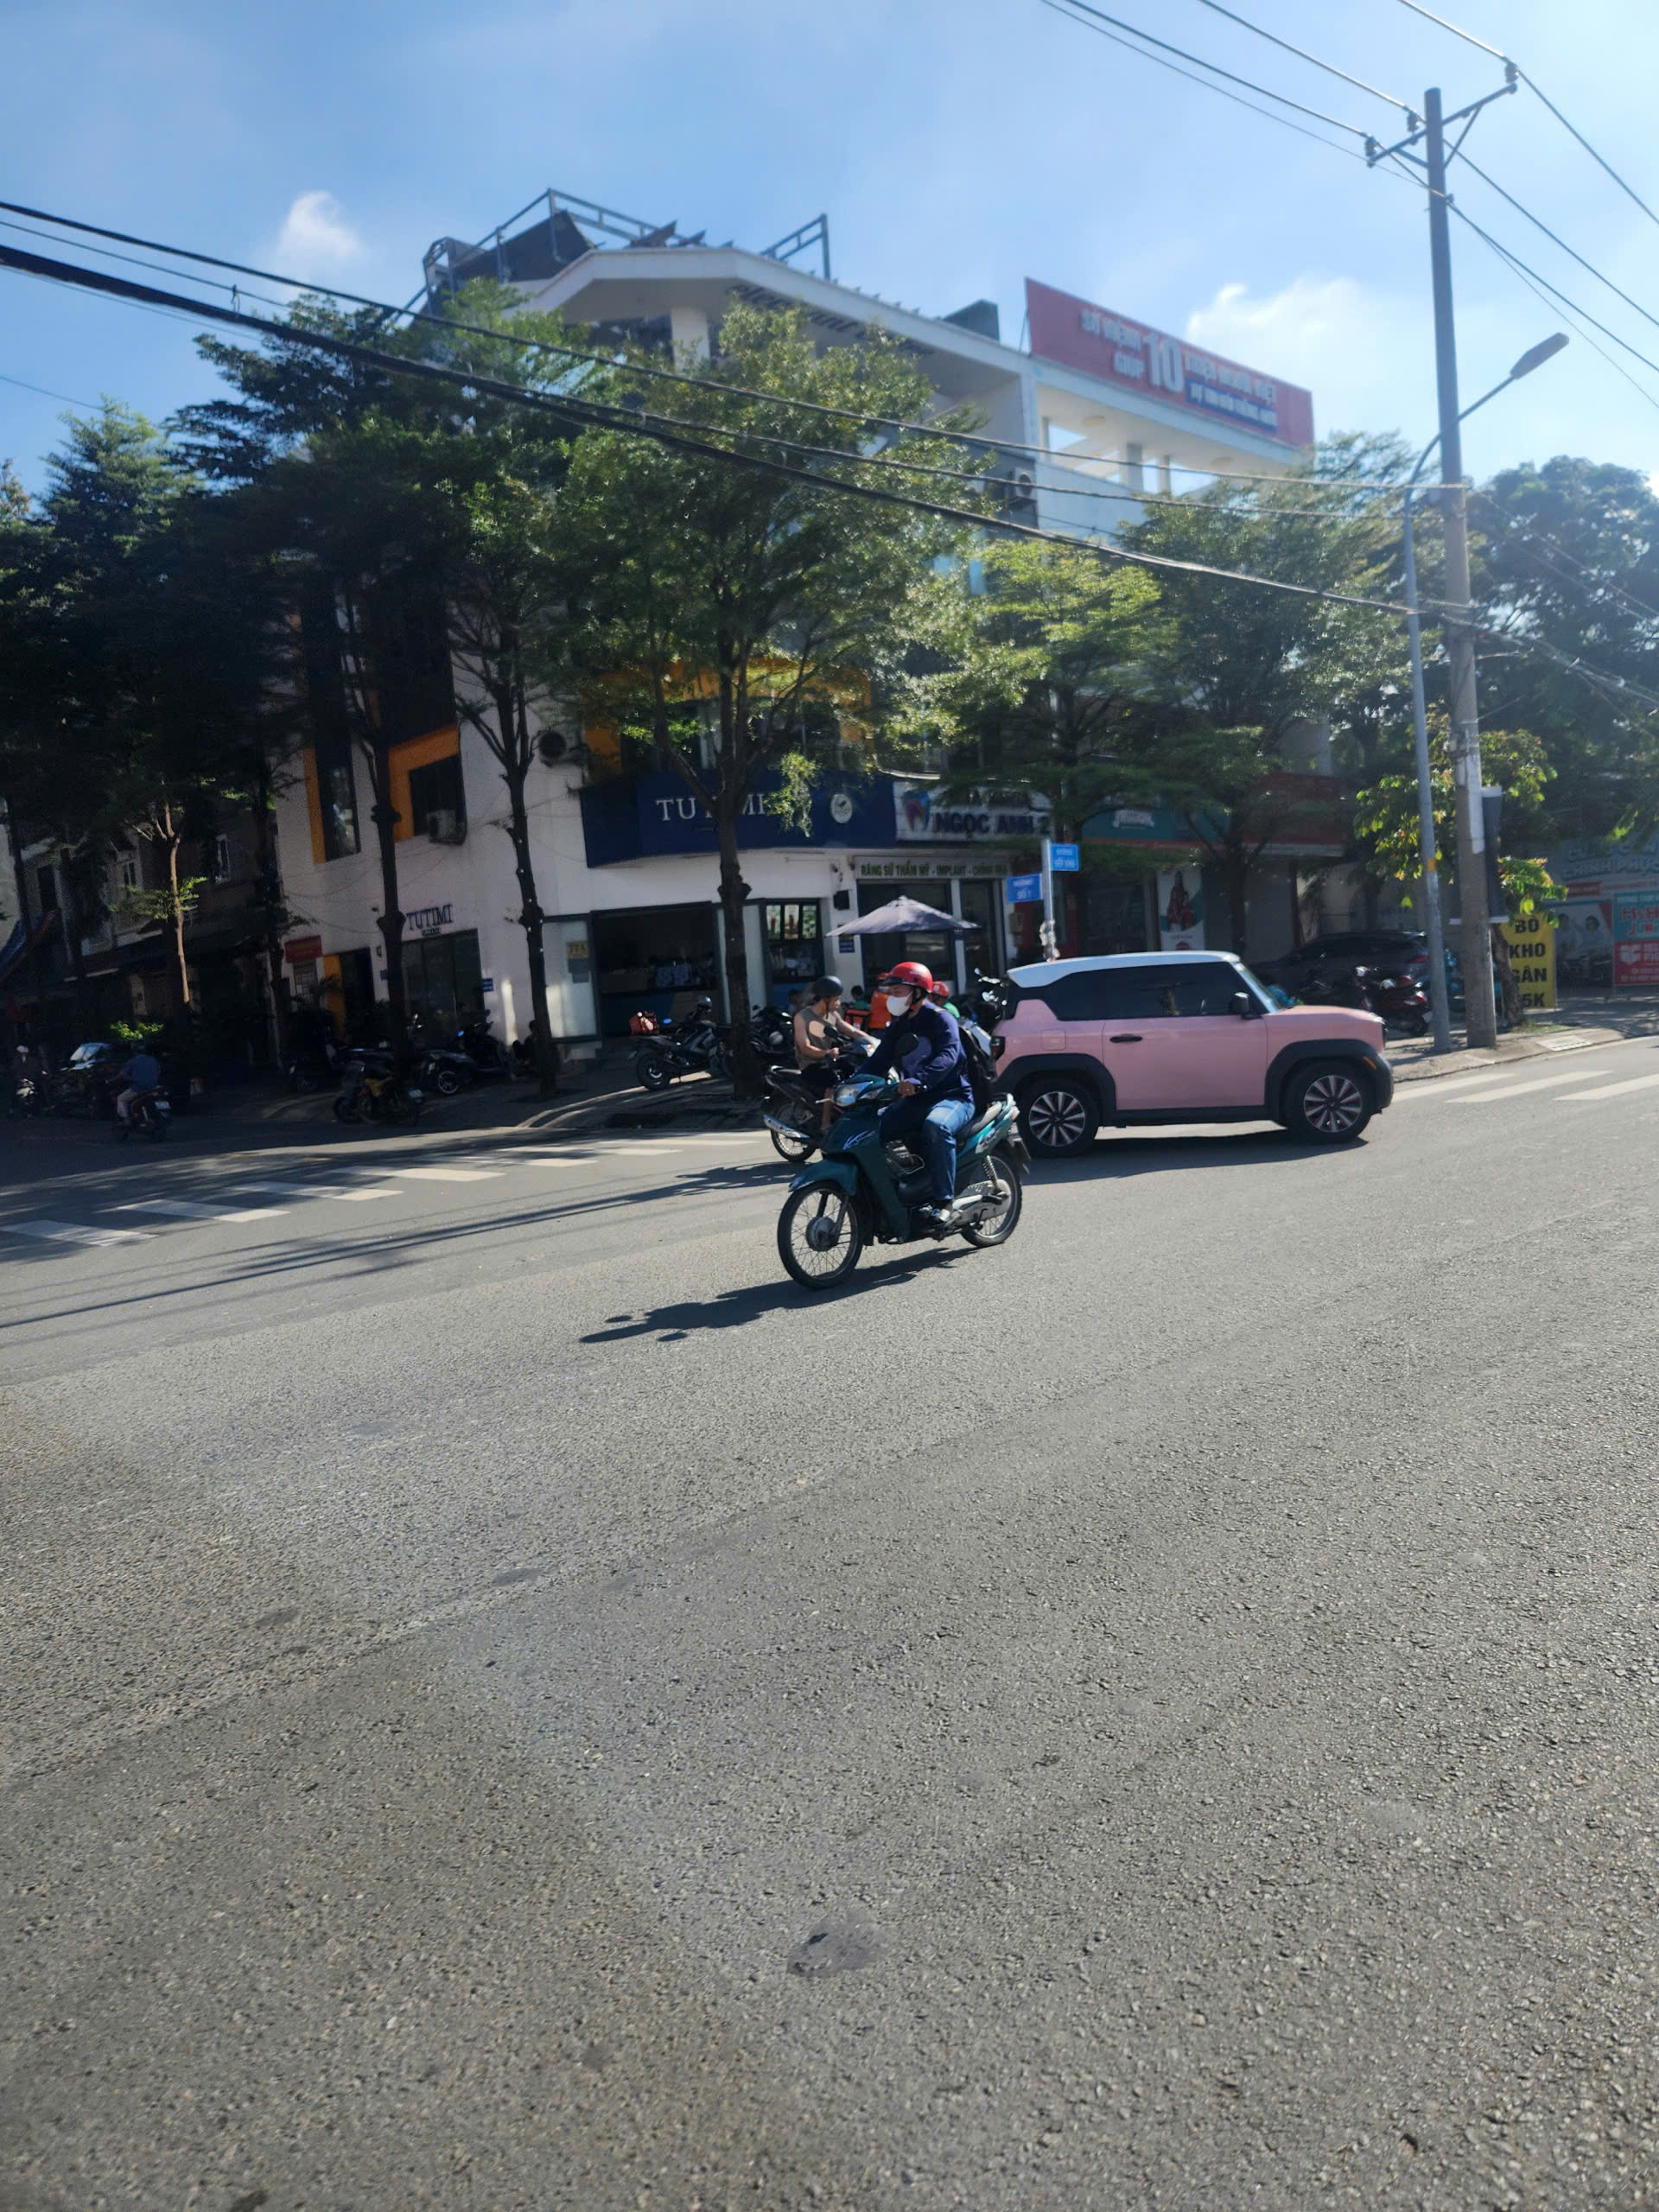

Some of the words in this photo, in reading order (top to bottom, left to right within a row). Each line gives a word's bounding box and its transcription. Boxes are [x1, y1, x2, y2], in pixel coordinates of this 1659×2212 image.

[1146, 330, 1184, 393] 10
[933, 813, 989, 839] NGỌC
[996, 815, 1034, 836] ANH
[406, 904, 453, 930] TUTIMI
[1514, 915, 1539, 934] BÒ
[1510, 943, 1546, 959] KHO
